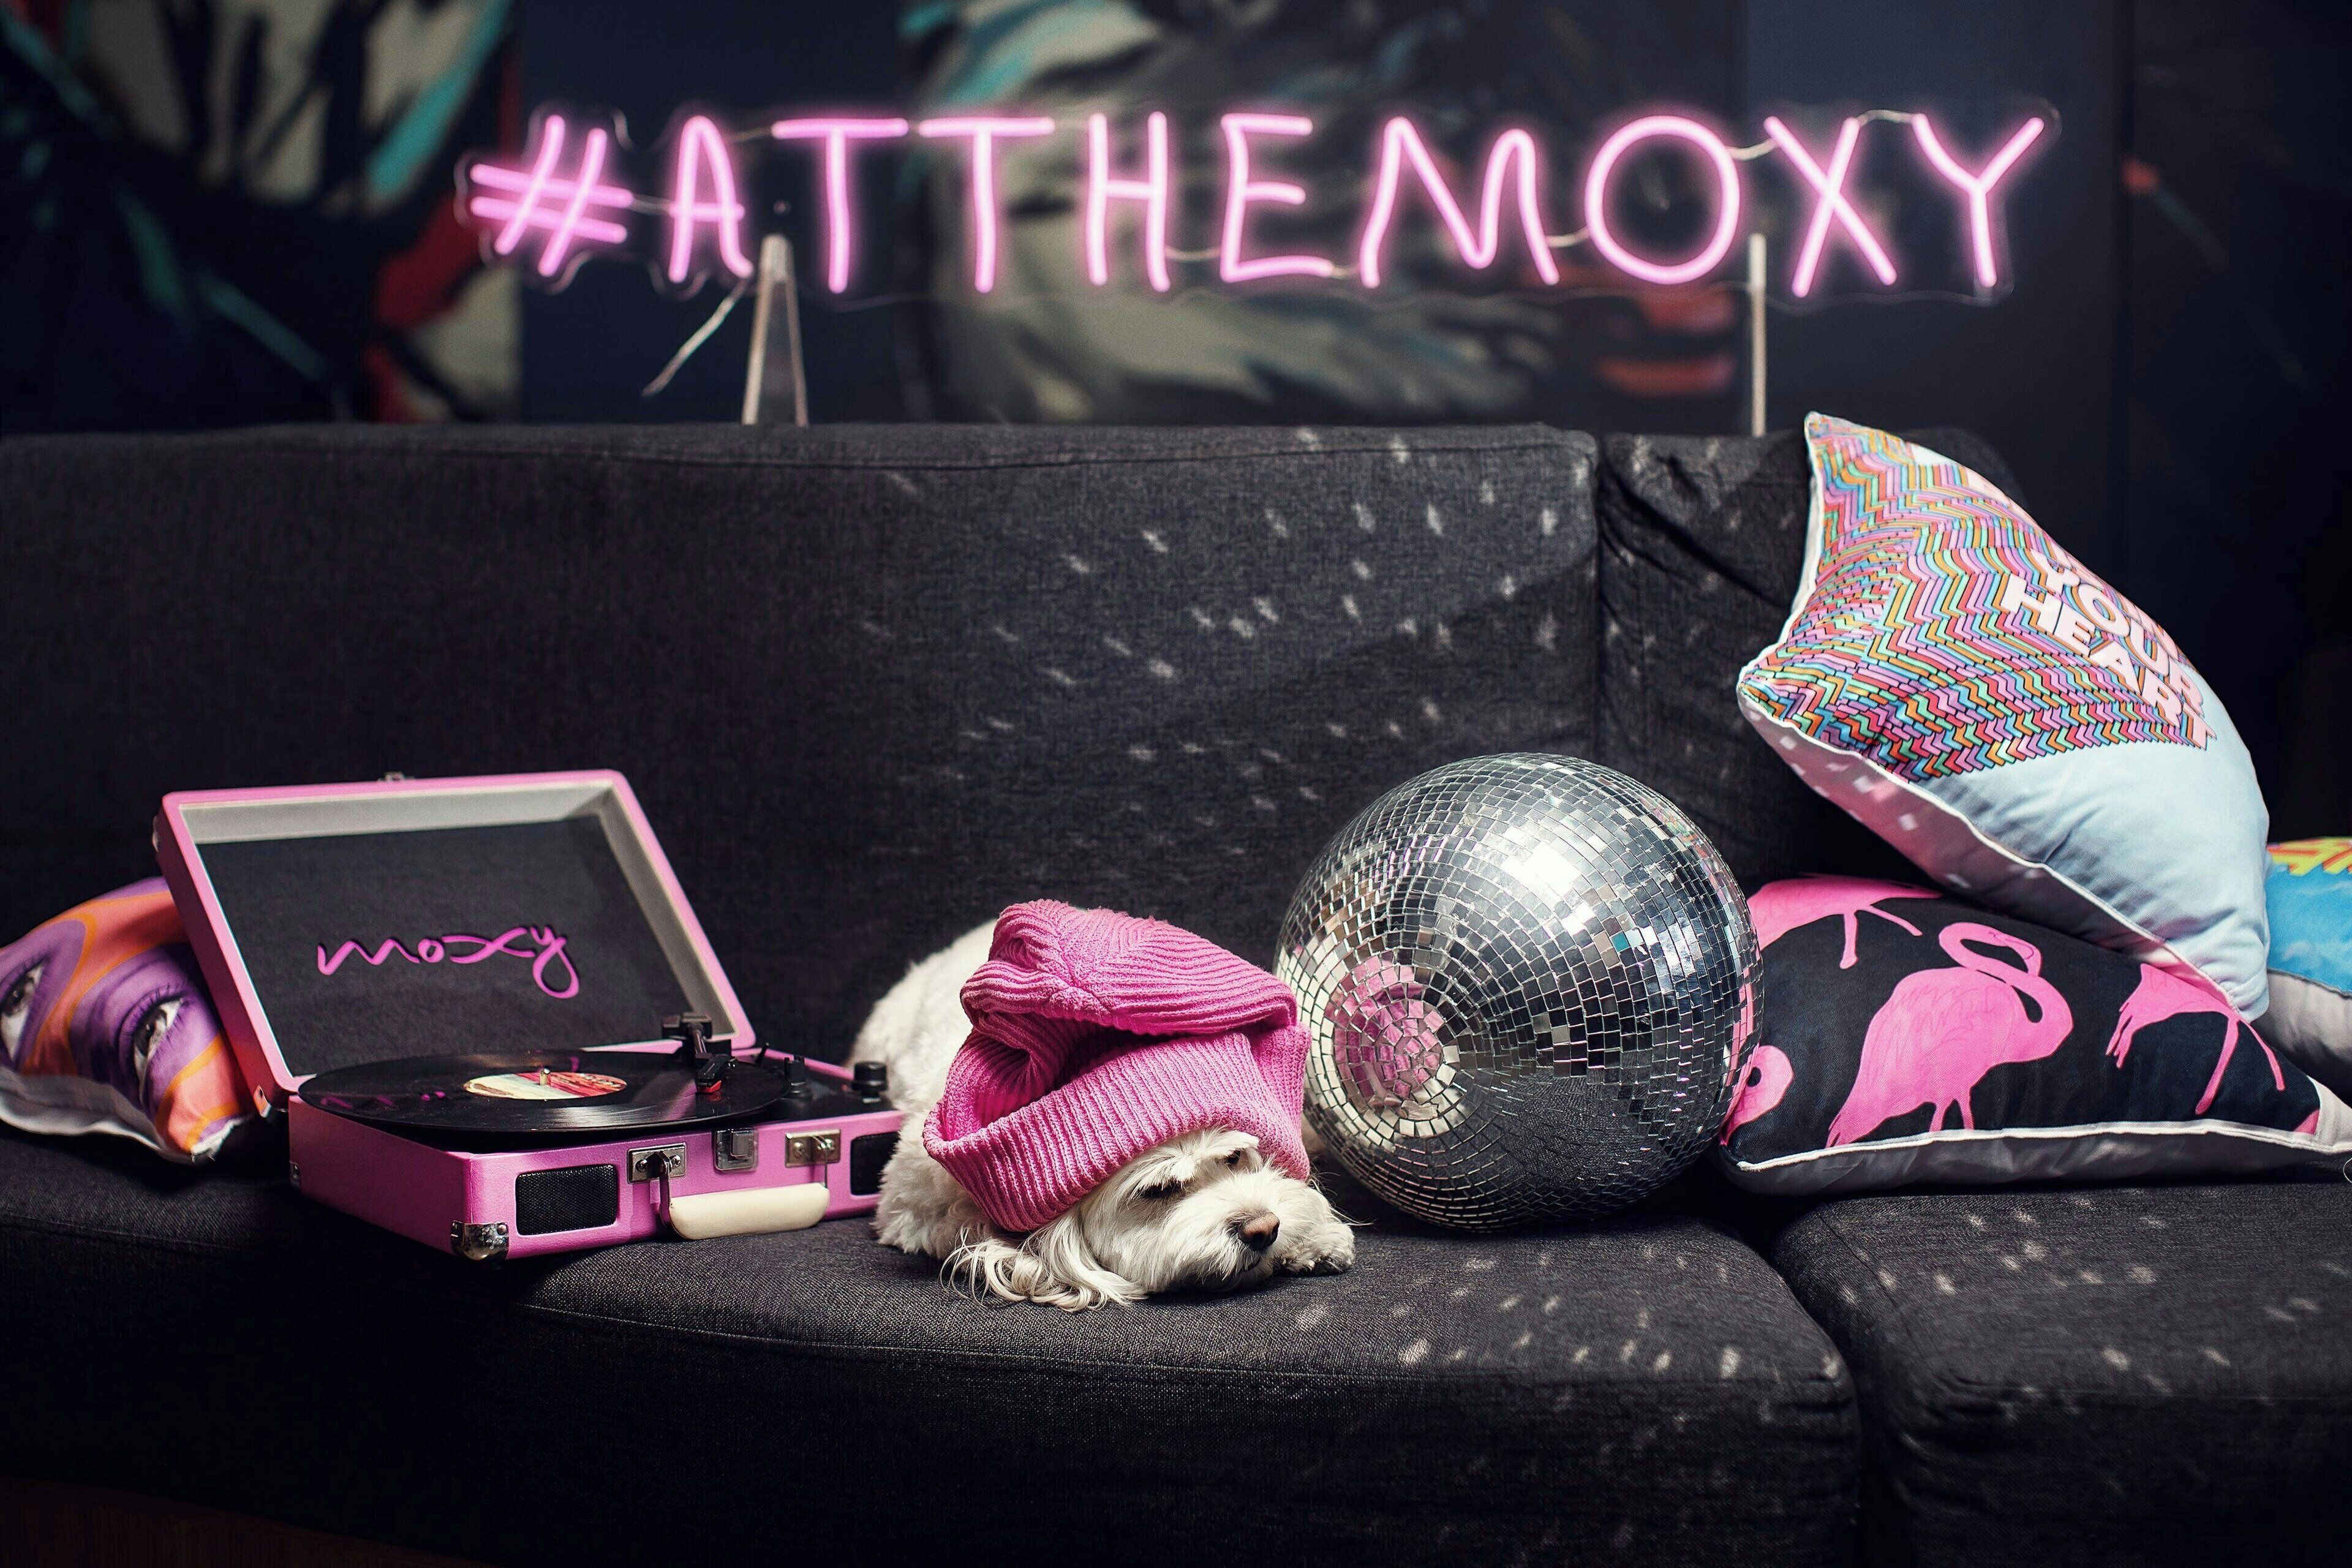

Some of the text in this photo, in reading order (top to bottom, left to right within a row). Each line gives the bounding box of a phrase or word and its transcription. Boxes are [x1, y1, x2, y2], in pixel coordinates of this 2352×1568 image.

[470, 112, 2045, 298] #ATTHEMOXY
[2000, 573, 2217, 751] HEART
[2030, 549, 2204, 717] YOUR
[316, 925, 581, 999] moxy
